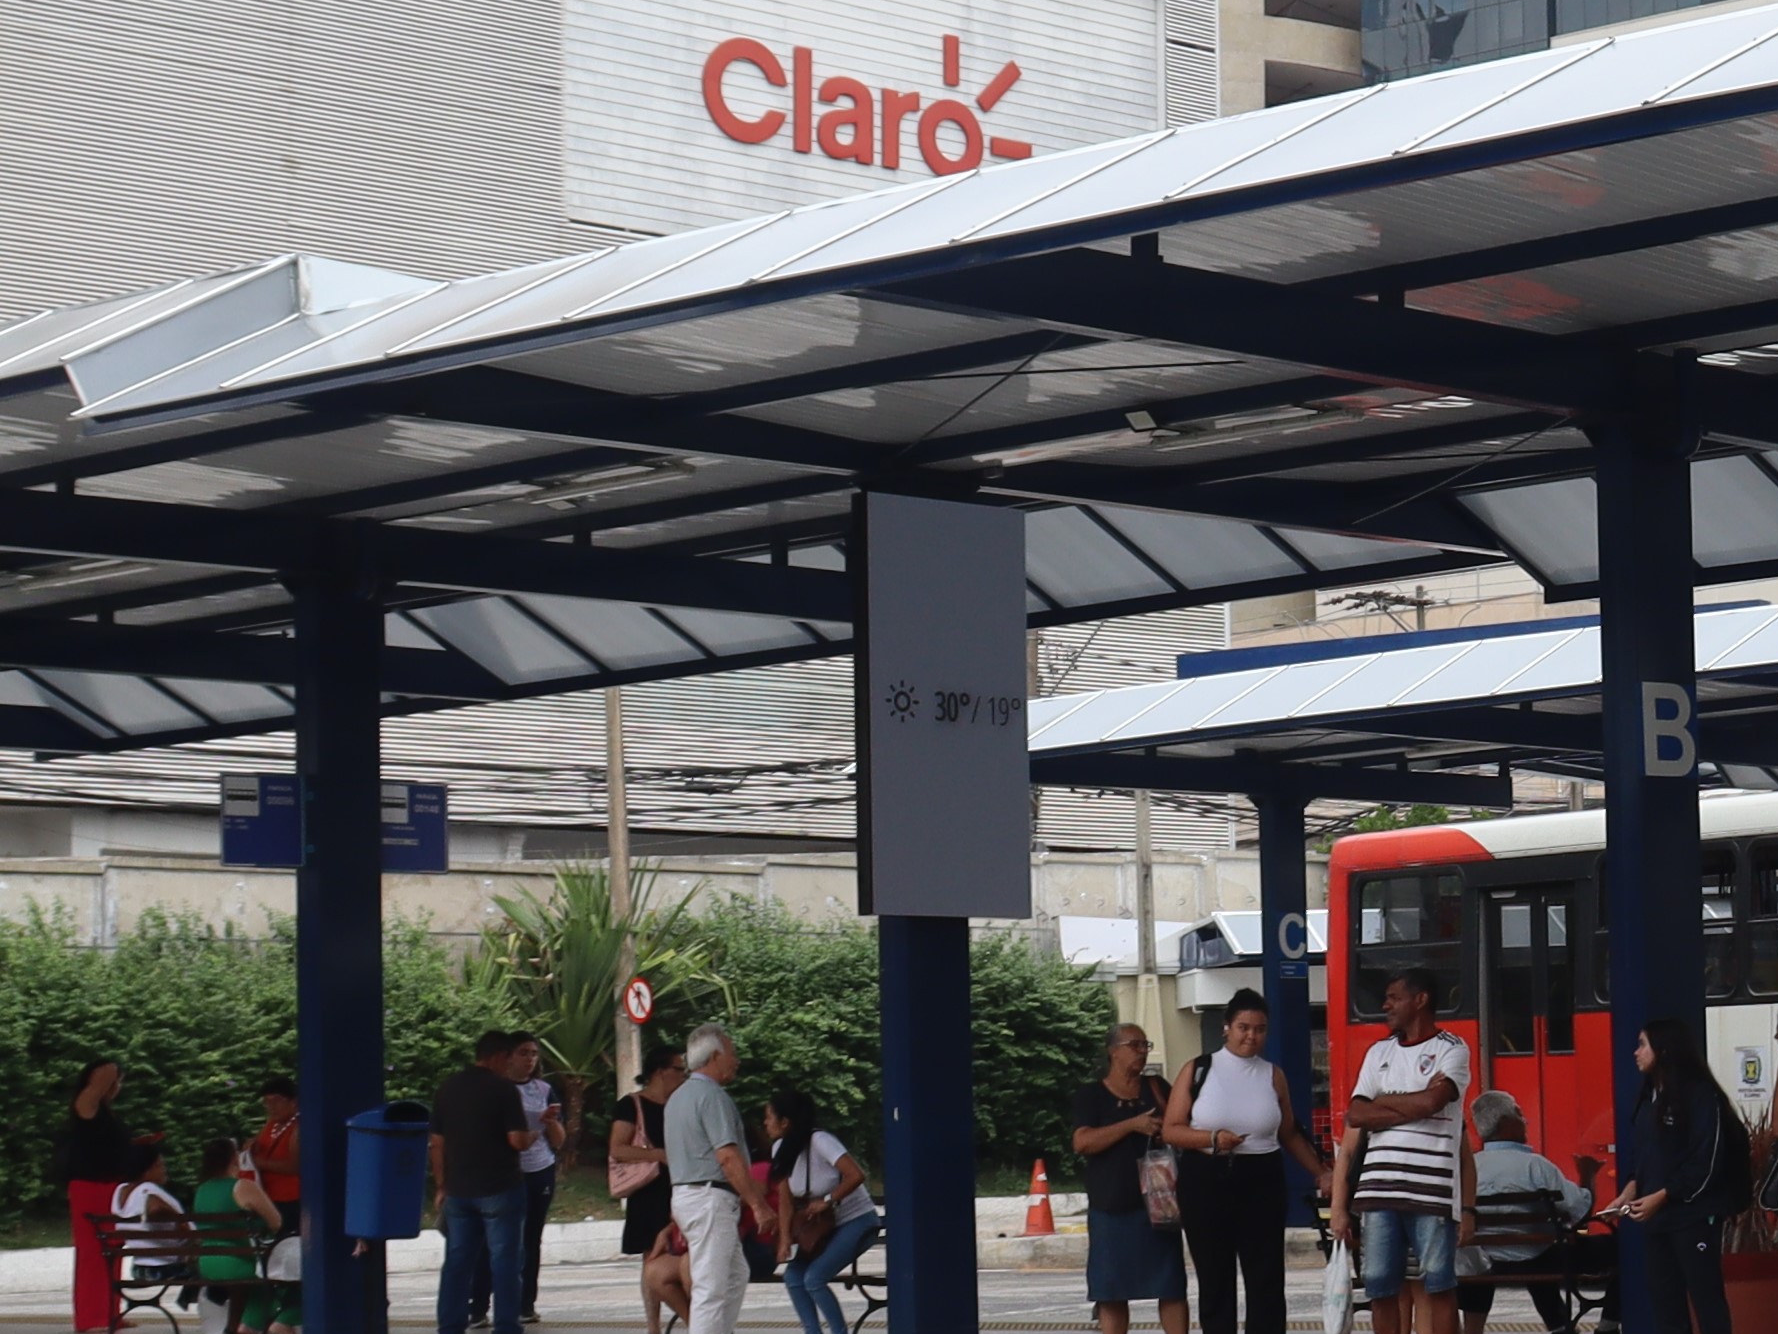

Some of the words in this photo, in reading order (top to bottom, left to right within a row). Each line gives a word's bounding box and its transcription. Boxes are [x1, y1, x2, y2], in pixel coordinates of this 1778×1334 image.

[701, 35, 984, 176] Claro
[1641, 680, 1696, 778] B
[1278, 912, 1306, 960] C
